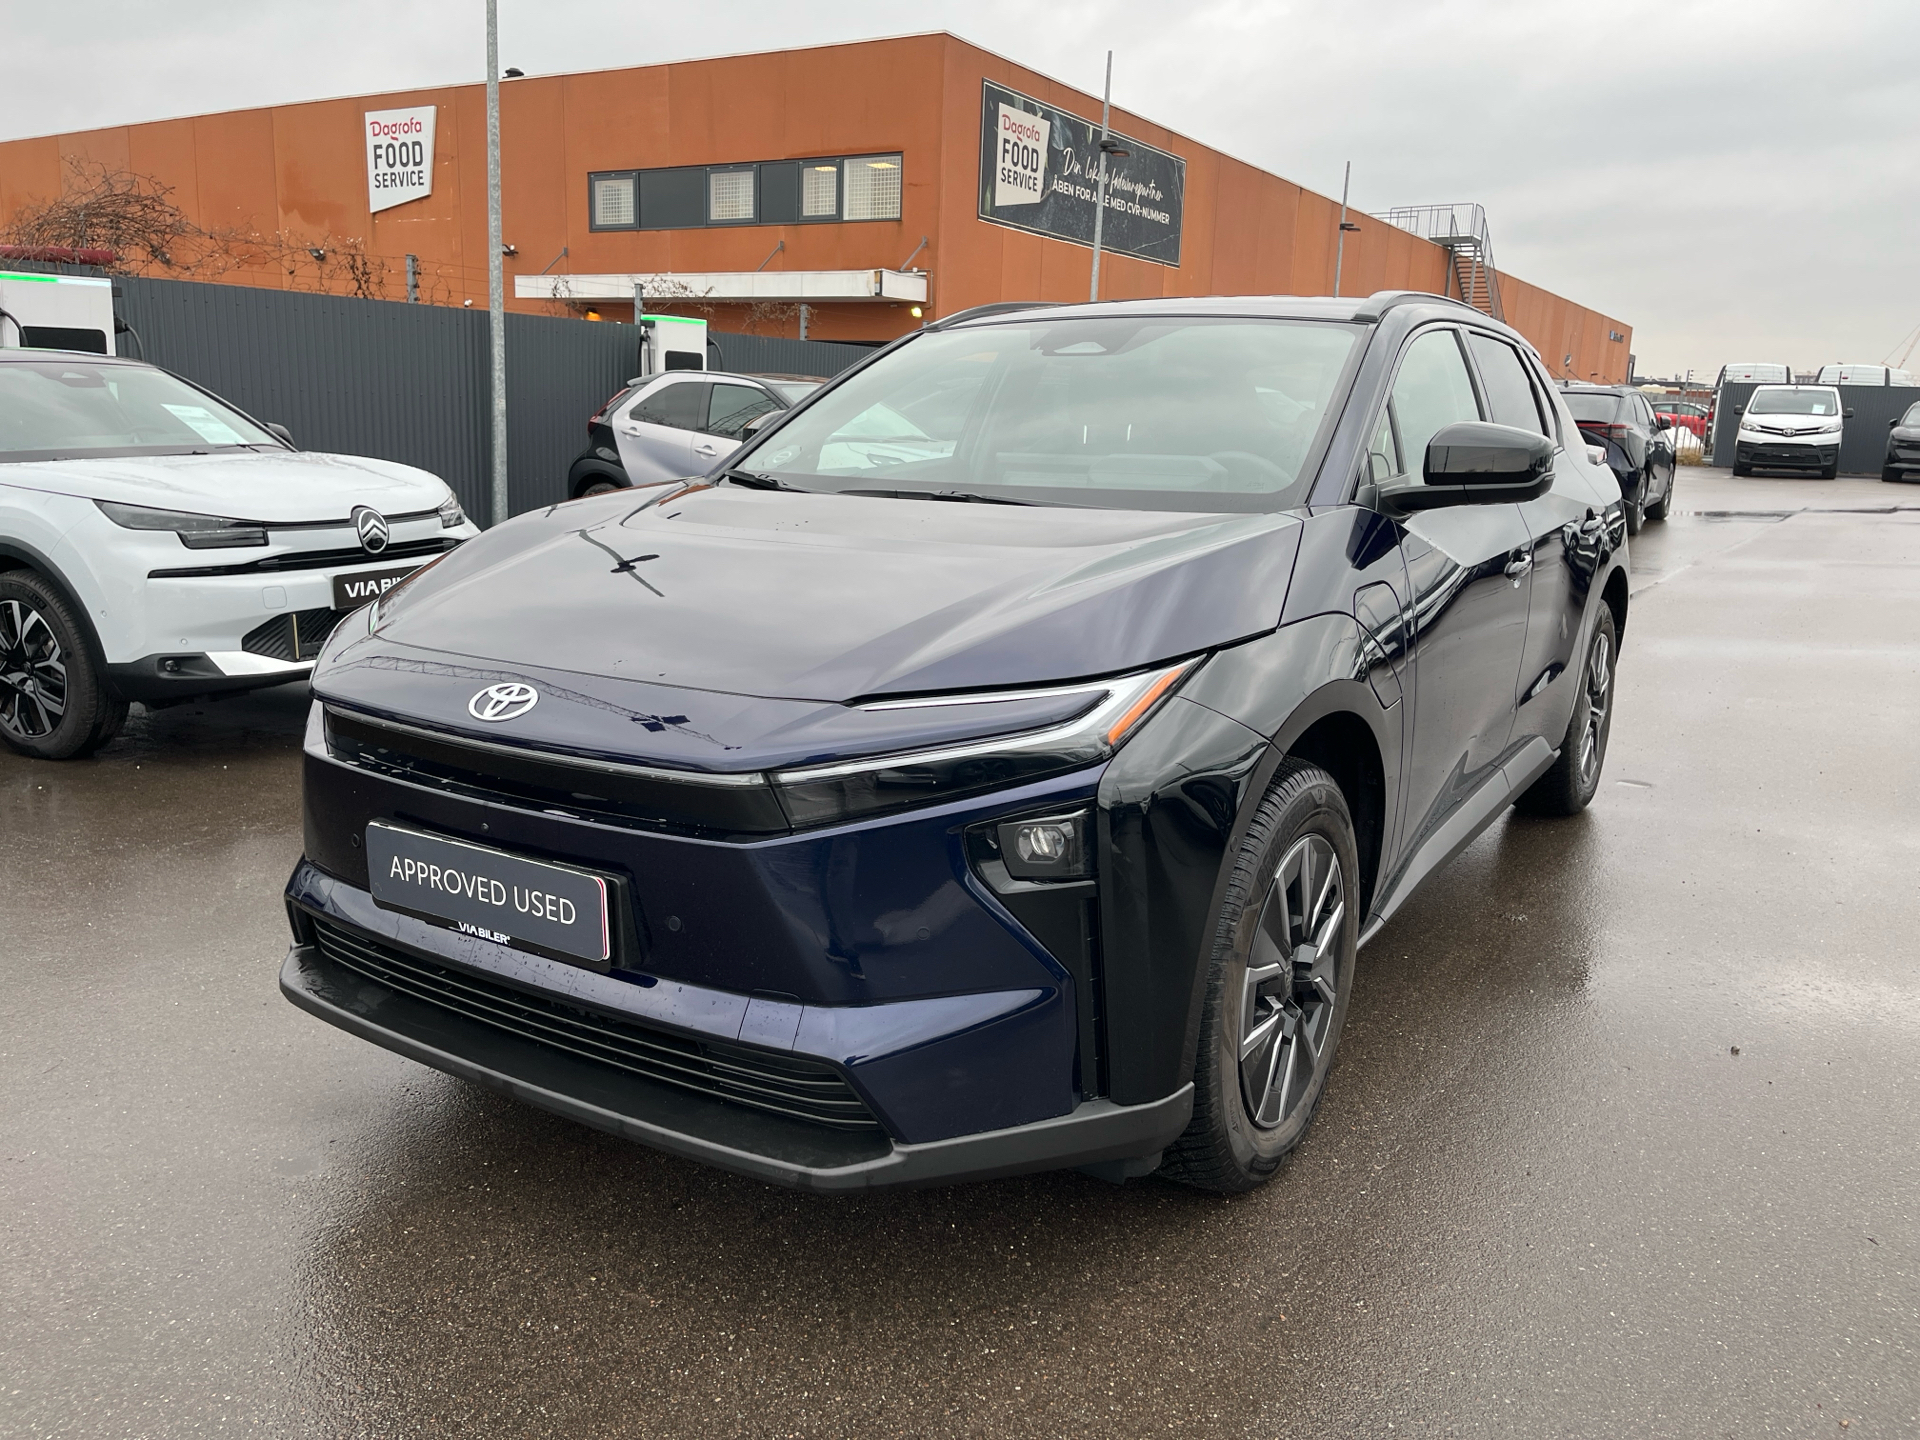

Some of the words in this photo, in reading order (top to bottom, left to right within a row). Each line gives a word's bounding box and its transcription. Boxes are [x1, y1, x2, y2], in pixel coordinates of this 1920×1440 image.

[370, 117, 422, 141] Dagrofa
[1002, 114, 1040, 142] Dagrofa
[373, 141, 424, 170] FOOD
[1002, 138, 1039, 173] FOOD
[1063, 147, 1081, 176] Din
[374, 170, 425, 188] SERVICE
[1001, 167, 1038, 192] SERVICE
[1052, 174, 1074, 196] ÅBEN
[1075, 186, 1091, 201] FOR
[1110, 197, 1126, 211] MED
[1127, 202, 1170, 225] CVR-NUMMER
[390, 855, 507, 906] APPROVED
[514, 885, 576, 925] USED
